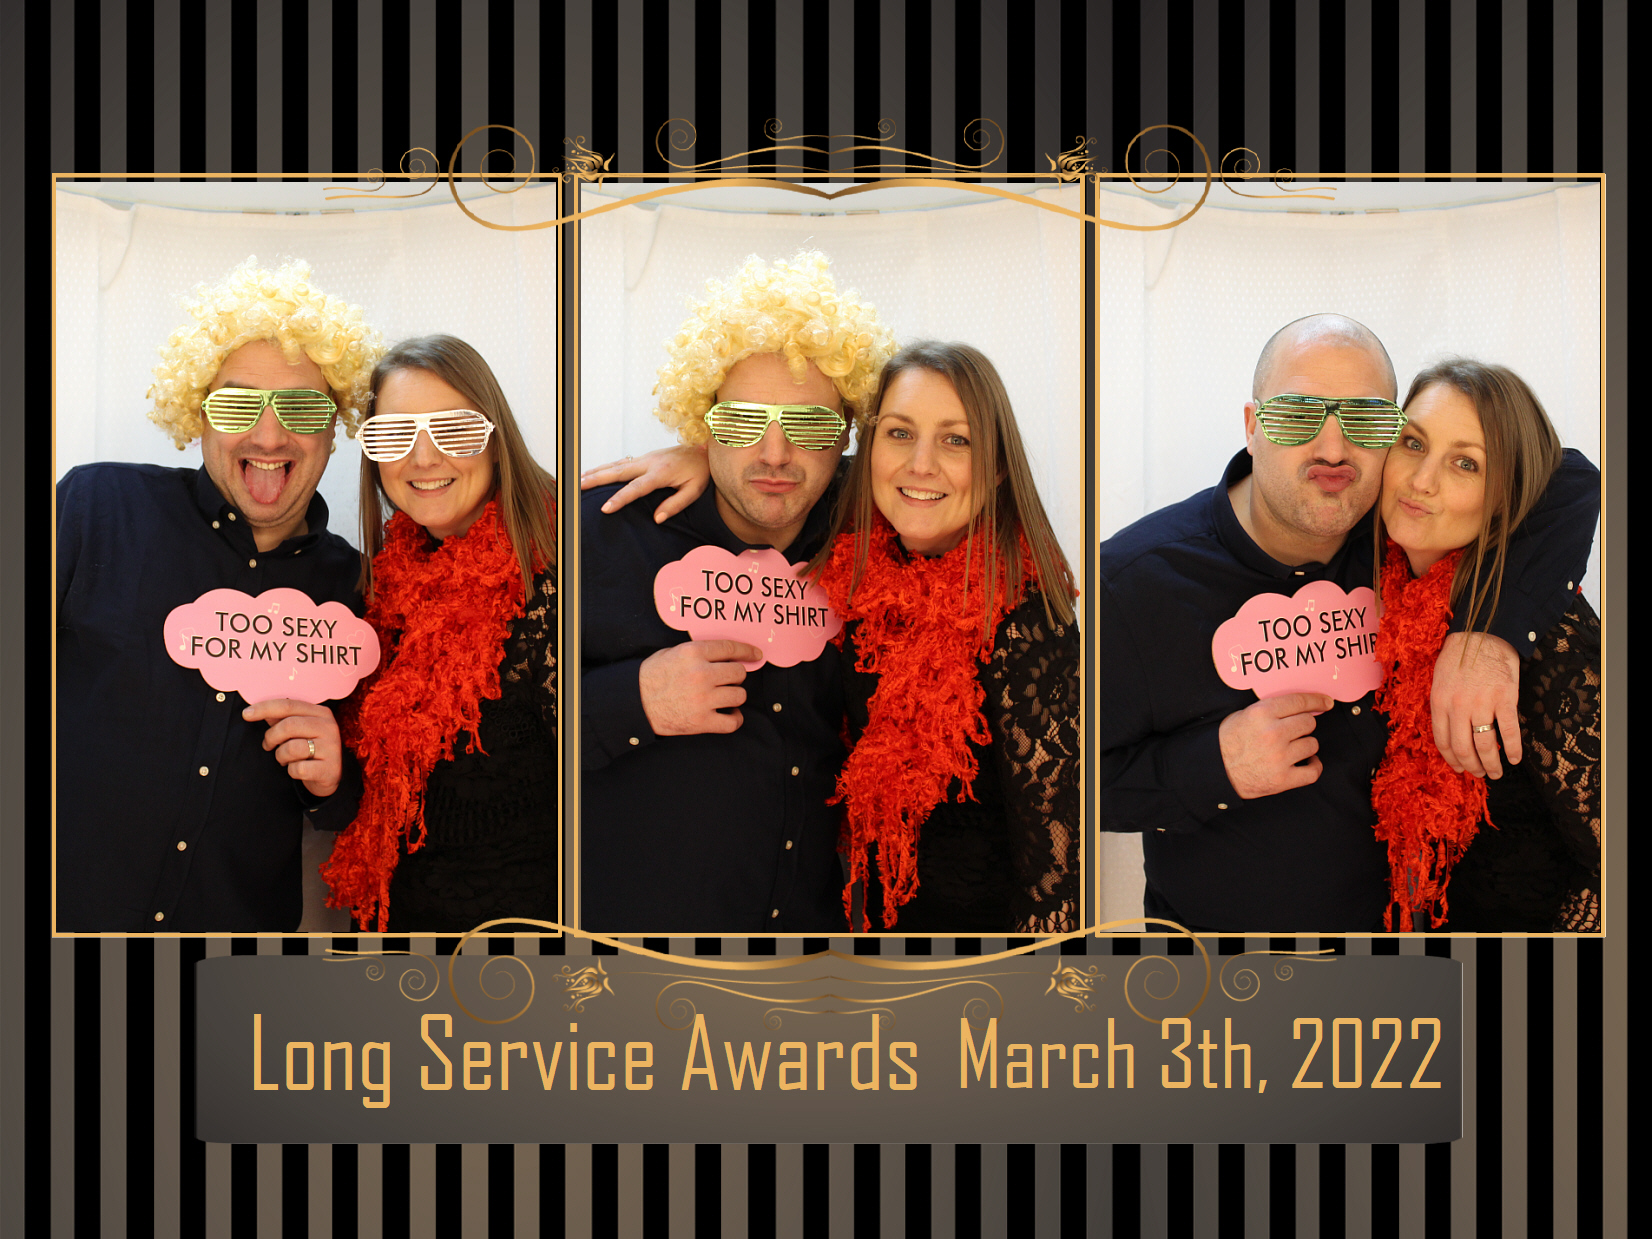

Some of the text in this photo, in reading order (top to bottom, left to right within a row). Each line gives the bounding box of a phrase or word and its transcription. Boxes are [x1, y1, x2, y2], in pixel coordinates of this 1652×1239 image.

[702, 569, 808, 600] TOO SEXY
[215, 611, 337, 639] TOO SEXY
[680, 595, 828, 627] FOR MY SHIRT
[1258, 606, 1367, 642] TOO SEXY
[190, 635, 361, 666] FOR MY SHIRT
[1240, 632, 1378, 676] FOR MY SHIR
